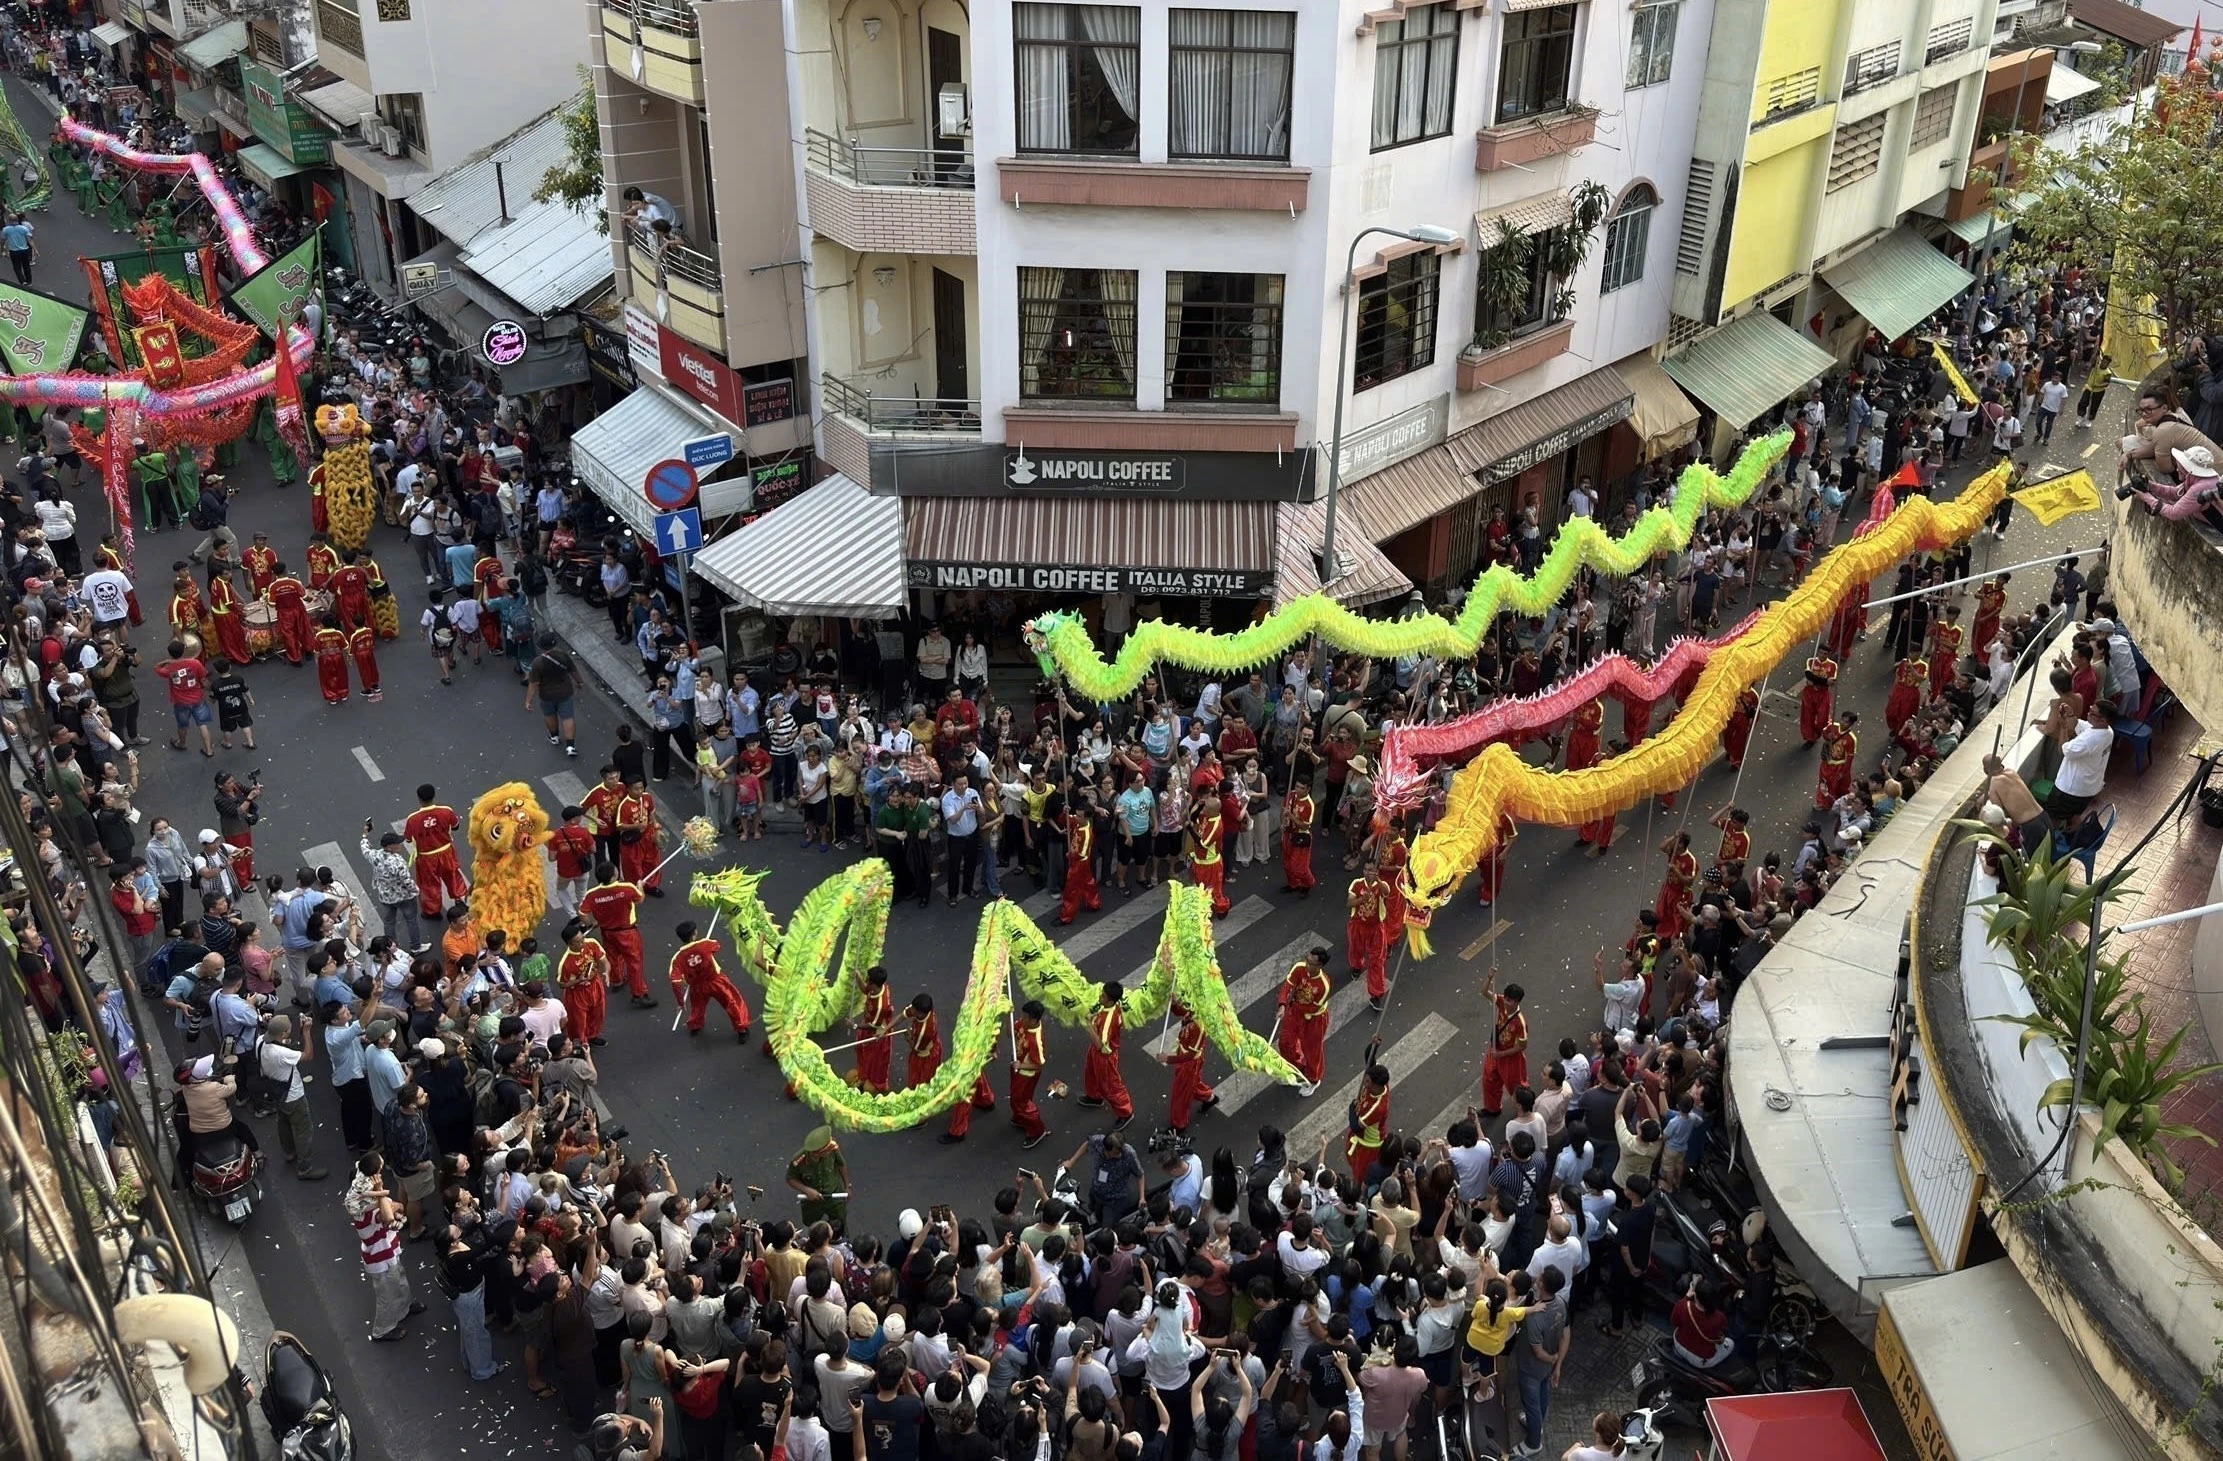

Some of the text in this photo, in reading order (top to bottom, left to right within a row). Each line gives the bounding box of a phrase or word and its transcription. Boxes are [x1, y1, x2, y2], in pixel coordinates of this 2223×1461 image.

[678, 352, 718, 388] Viettel
[696, 380, 719, 402] telecom
[1354, 416, 1427, 467] NAPOLI COFFEE
[1497, 449, 1532, 478] NAPOLI
[1536, 431, 1569, 463] COFFEE
[1041, 460, 1172, 481] NAPOLI COFFEE
[757, 478, 785, 495] QUỐC
[936, 566, 1245, 592] NAPOLI COFFEE ITALIA STYLE
[1162, 586, 1231, 597] 0973.831.713
[1896, 1356, 1948, 1461] TRÀ SỮ
